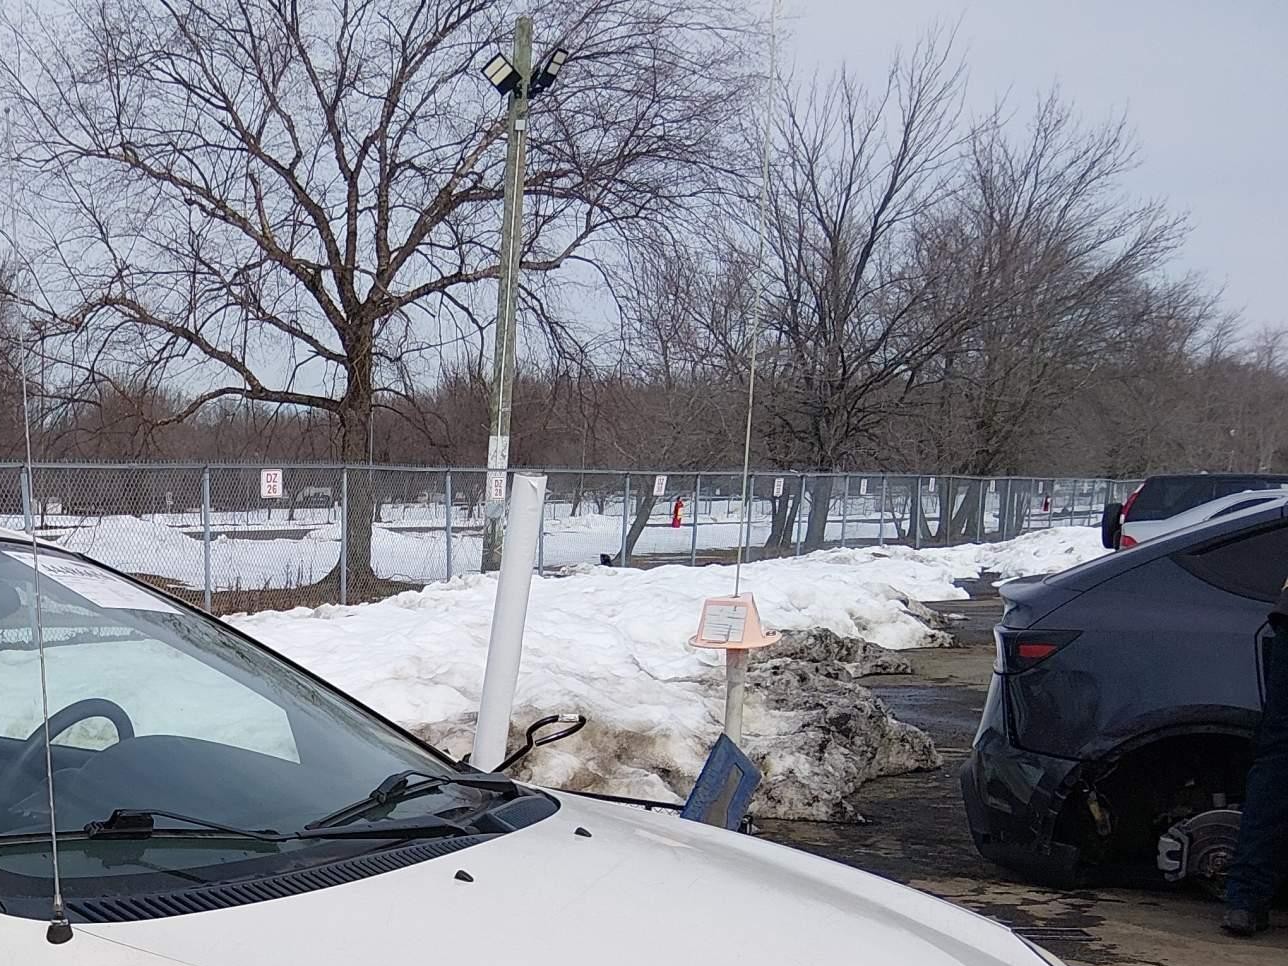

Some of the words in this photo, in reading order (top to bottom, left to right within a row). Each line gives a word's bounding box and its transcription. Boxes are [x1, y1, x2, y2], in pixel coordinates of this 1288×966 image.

[266, 472, 278, 484] DZ
[494, 479, 503, 488] DZ
[267, 484, 277, 494] 26
